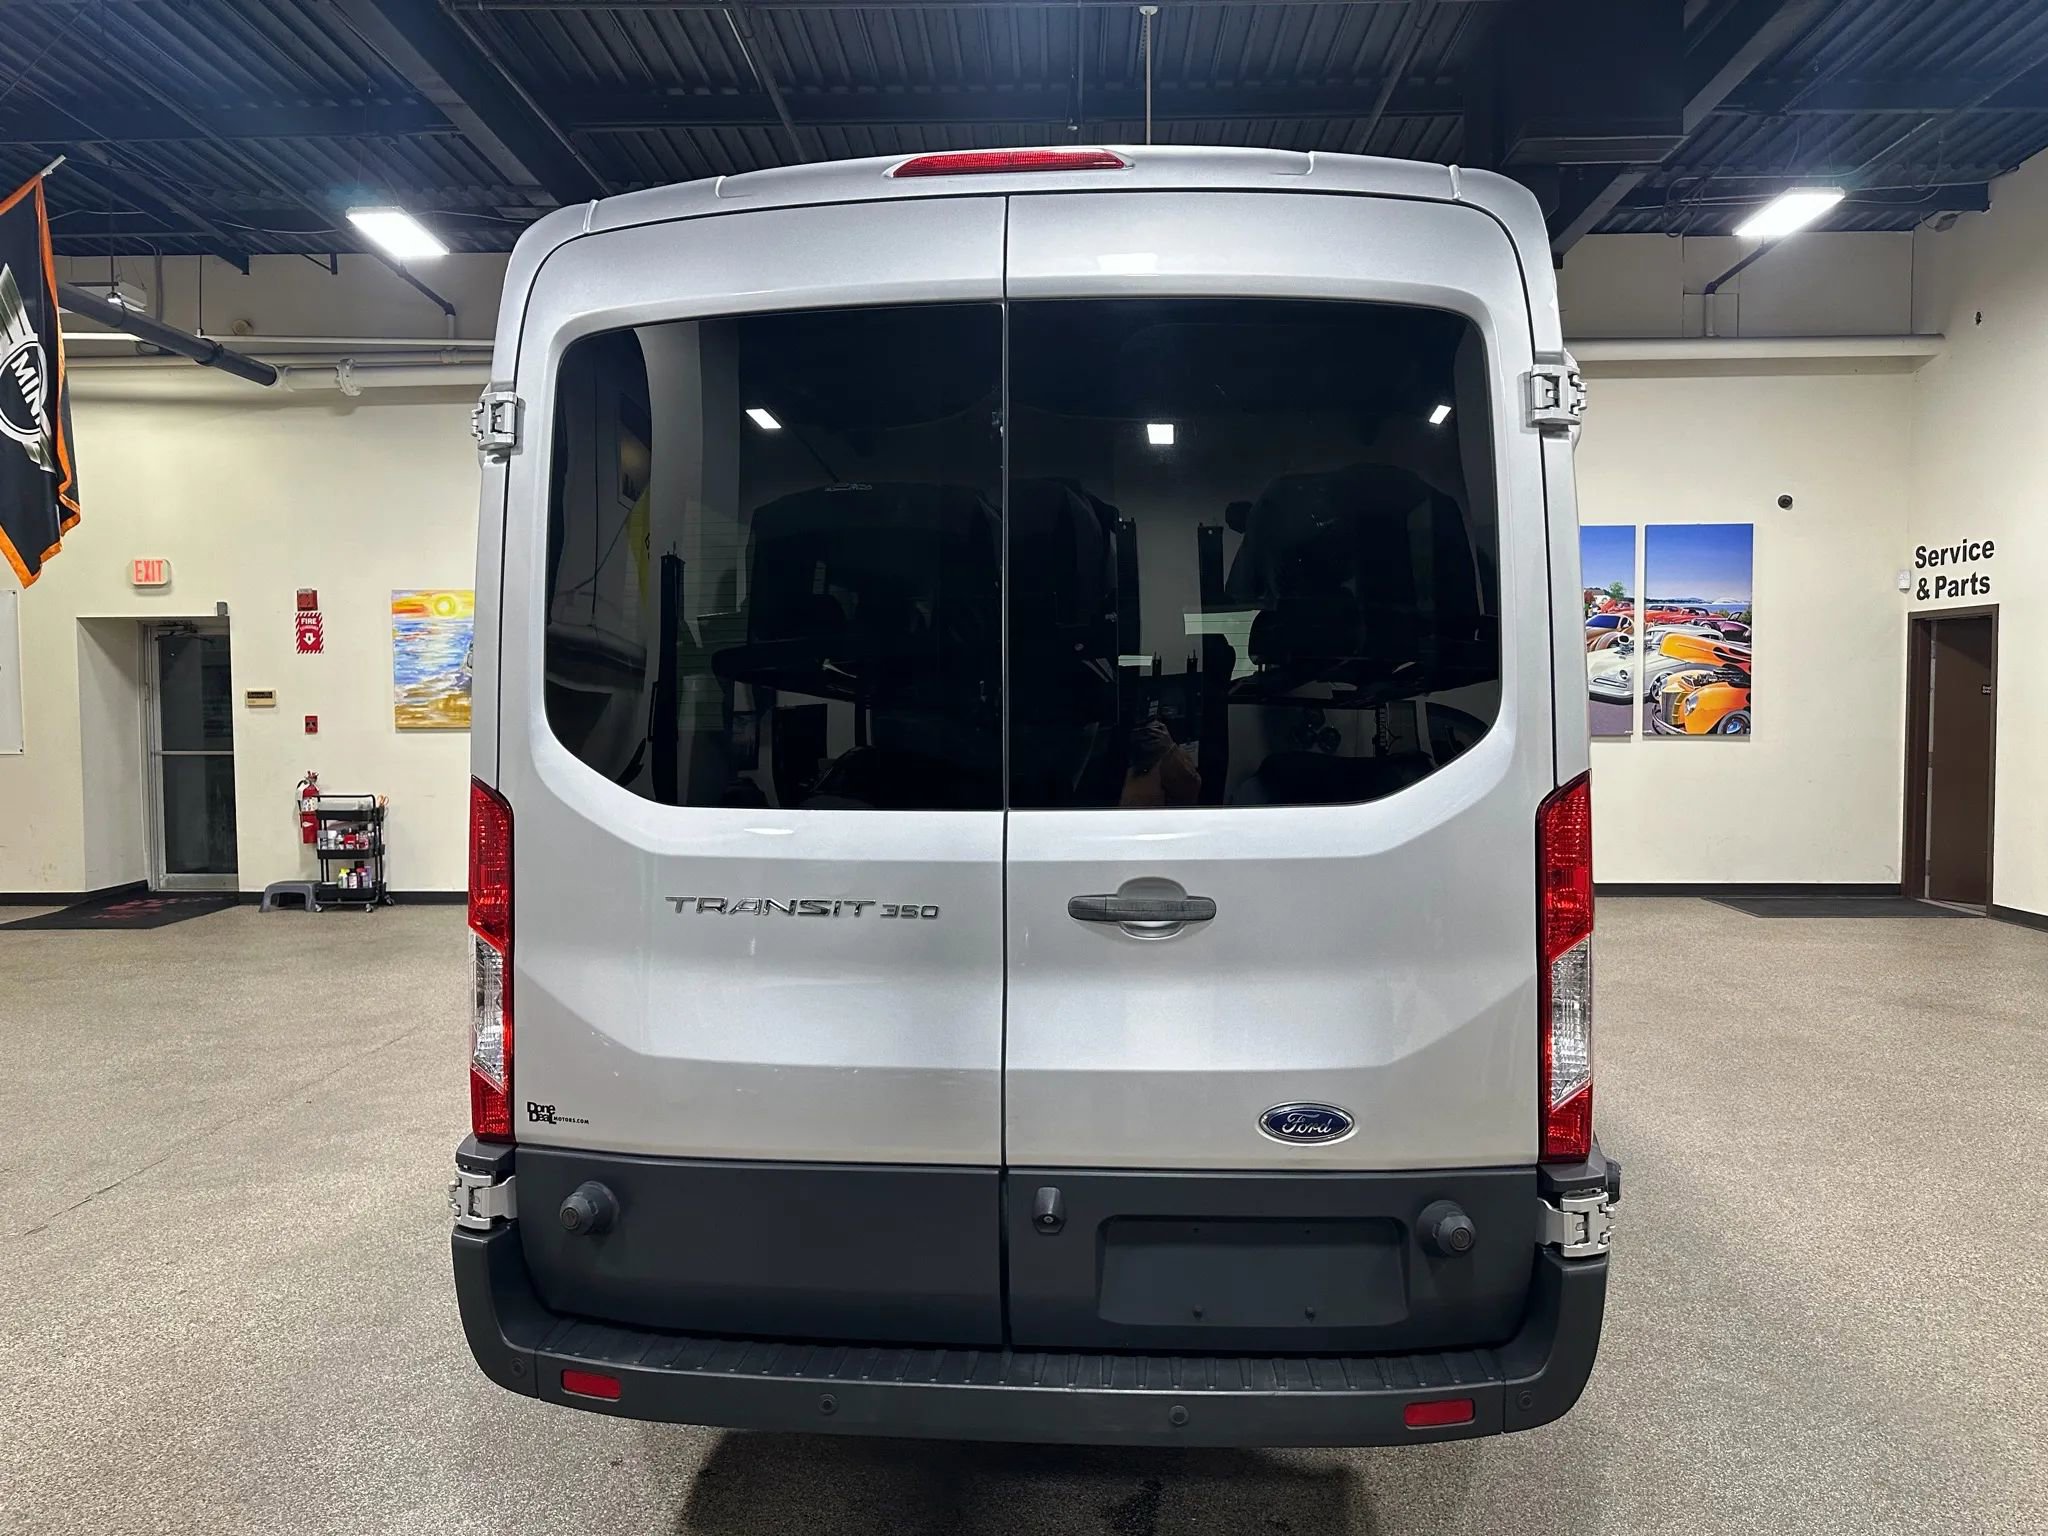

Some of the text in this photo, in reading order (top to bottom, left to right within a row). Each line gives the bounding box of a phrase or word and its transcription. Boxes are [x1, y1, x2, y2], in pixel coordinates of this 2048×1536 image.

[1914, 538, 1995, 569] Service
[134, 560, 164, 582] EXIT
[1916, 572, 1990, 601] & Parts
[300, 617, 318, 625] FIRE
[665, 896, 940, 919] TRANSIT 350
[527, 1101, 556, 1115] Done
[1281, 1112, 1332, 1134] Ford
